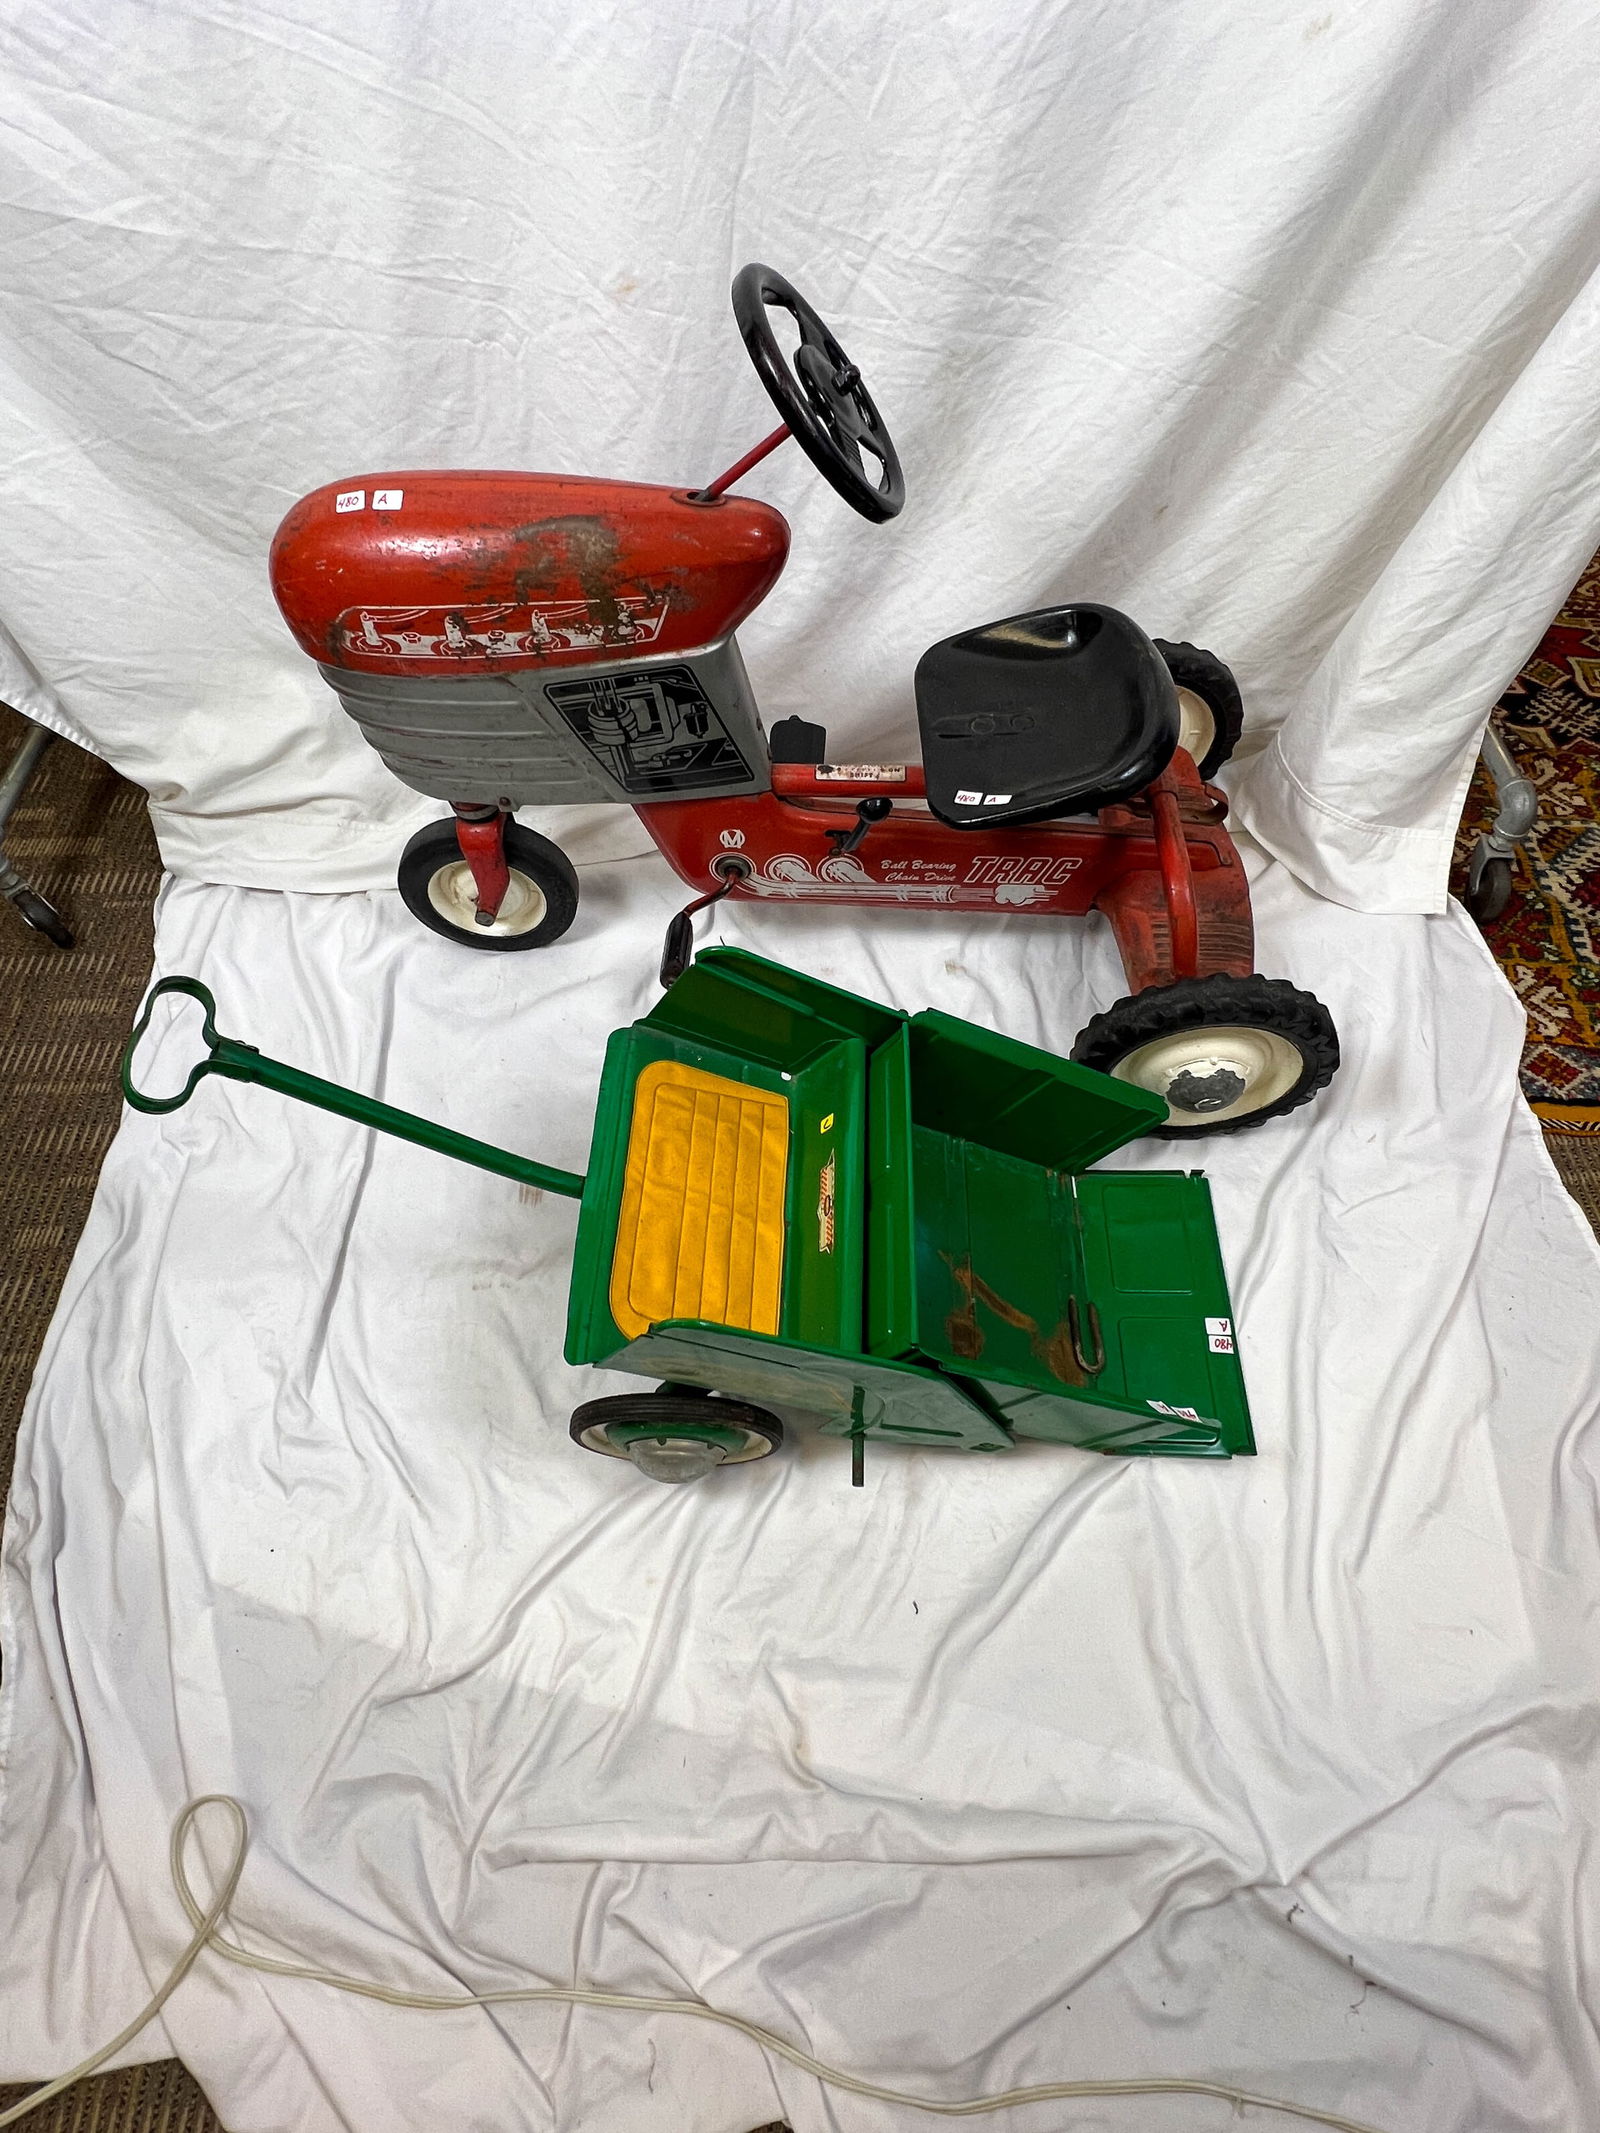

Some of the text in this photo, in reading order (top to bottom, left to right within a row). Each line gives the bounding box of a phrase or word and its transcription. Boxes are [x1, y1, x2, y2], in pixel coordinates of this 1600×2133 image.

[338, 495, 359, 509] 480
[377, 493, 388, 505] A
[880, 859, 957, 873] Ball Bearing
[963, 855, 1083, 885] TRAC
[884, 871, 957, 883] Chain Drive
[1218, 1320, 1228, 1332] A
[1214, 1337, 1233, 1351] 480
